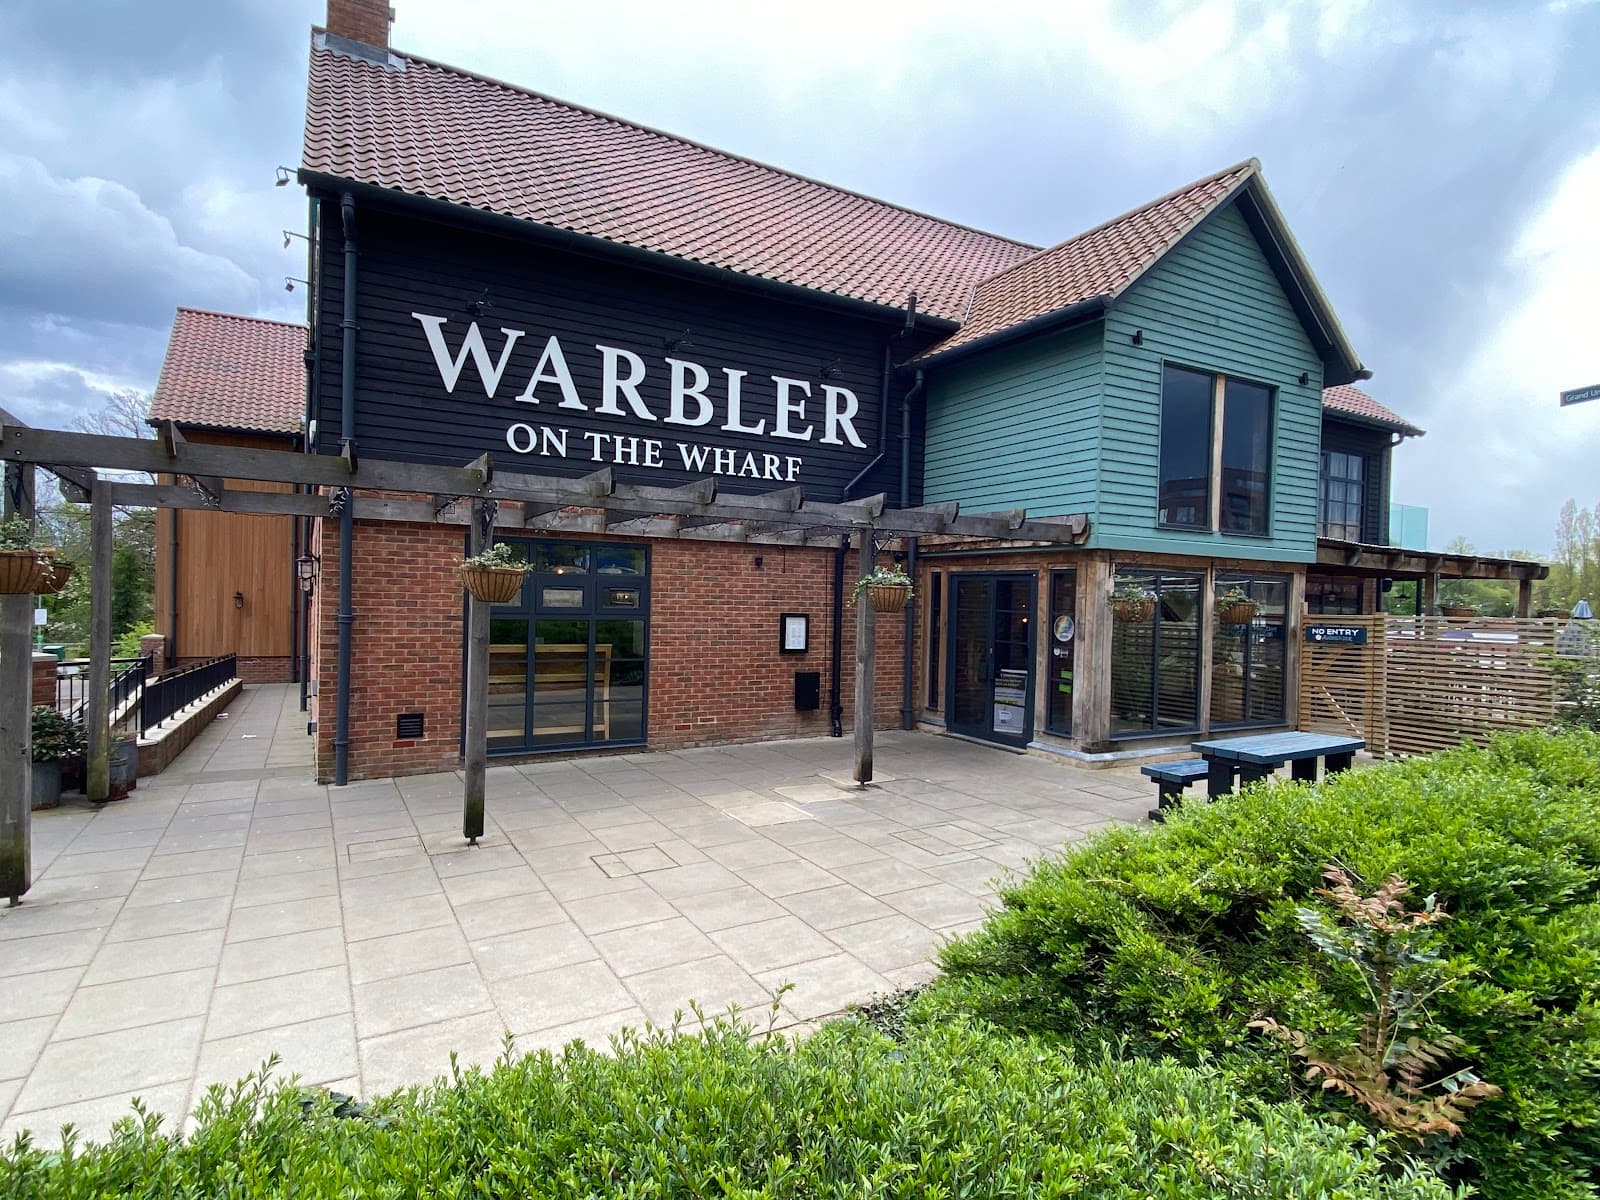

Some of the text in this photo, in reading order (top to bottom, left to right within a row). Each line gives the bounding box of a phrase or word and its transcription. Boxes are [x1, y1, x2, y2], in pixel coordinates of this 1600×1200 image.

[411, 311, 866, 449] WARBLER
[1565, 391, 1589, 402] Grand
[506, 423, 803, 482] ON THE WHARF
